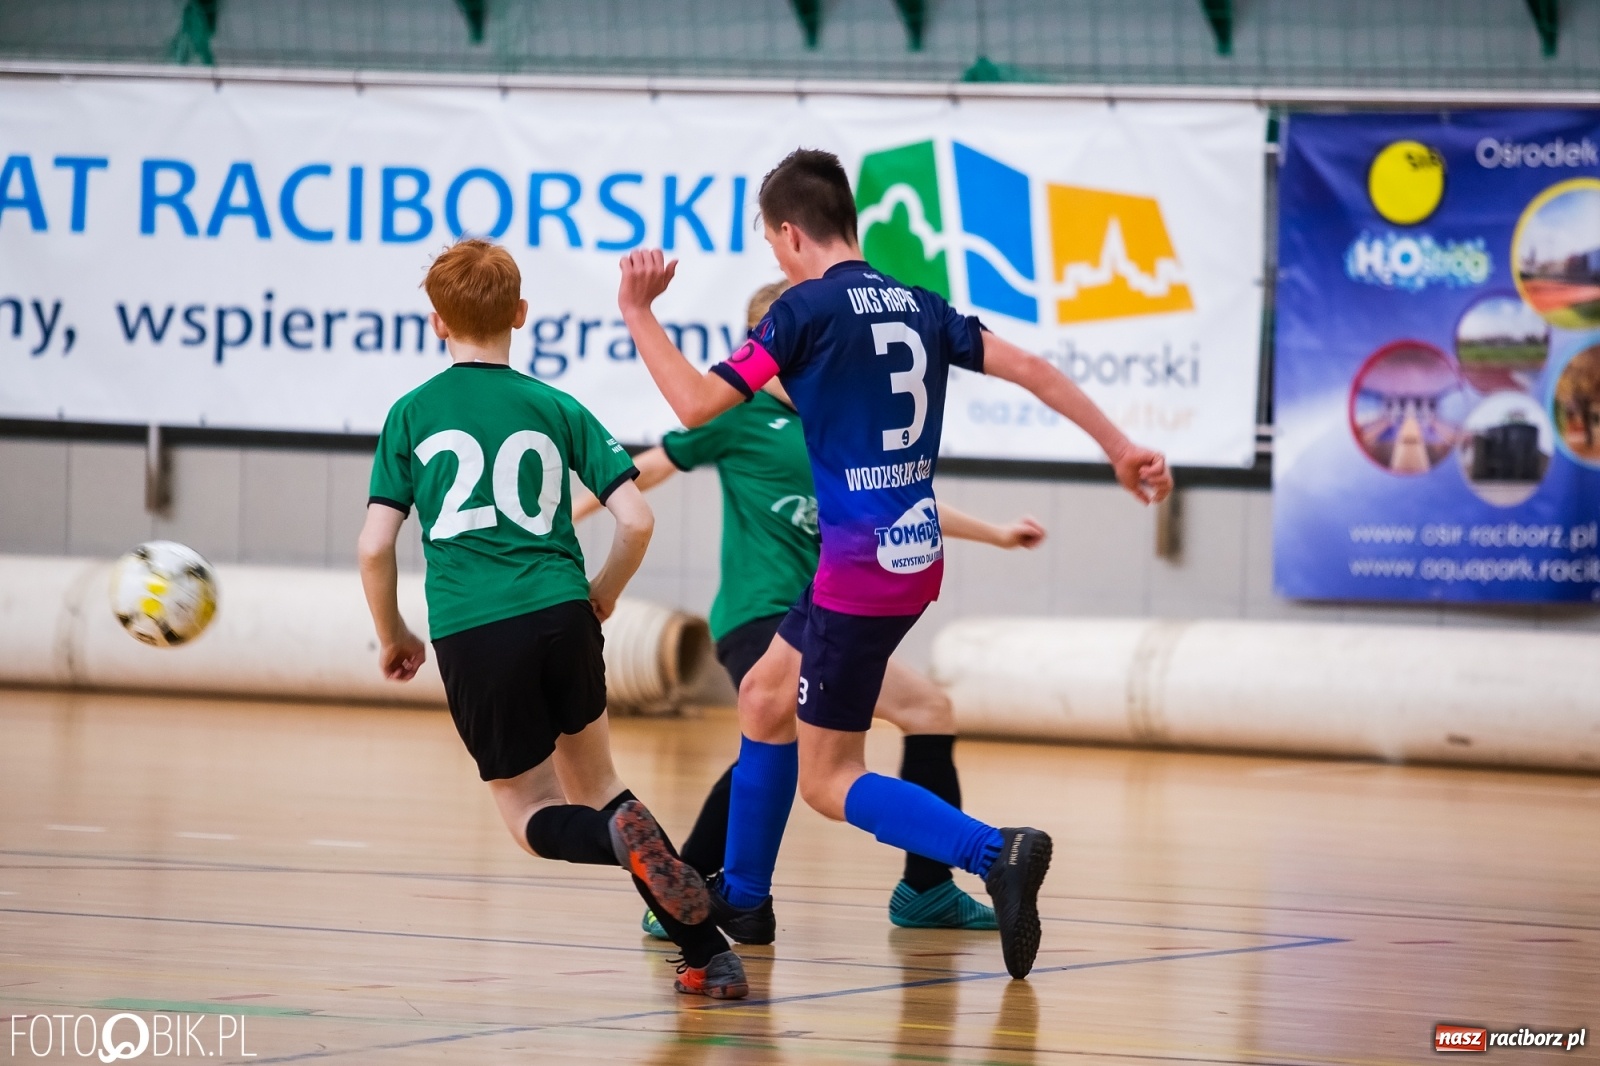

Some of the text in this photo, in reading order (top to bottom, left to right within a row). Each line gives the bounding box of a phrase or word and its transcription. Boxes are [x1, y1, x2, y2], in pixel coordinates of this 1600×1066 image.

[140, 159, 747, 253] RACIBORSKI
[116, 289, 446, 365] wspieram
[847, 287, 883, 314] UKS
[870, 321, 928, 451] 3
[413, 429, 563, 542] 20
[891, 554, 926, 569] WSZYSTKO
[798, 676, 809, 705] 3
